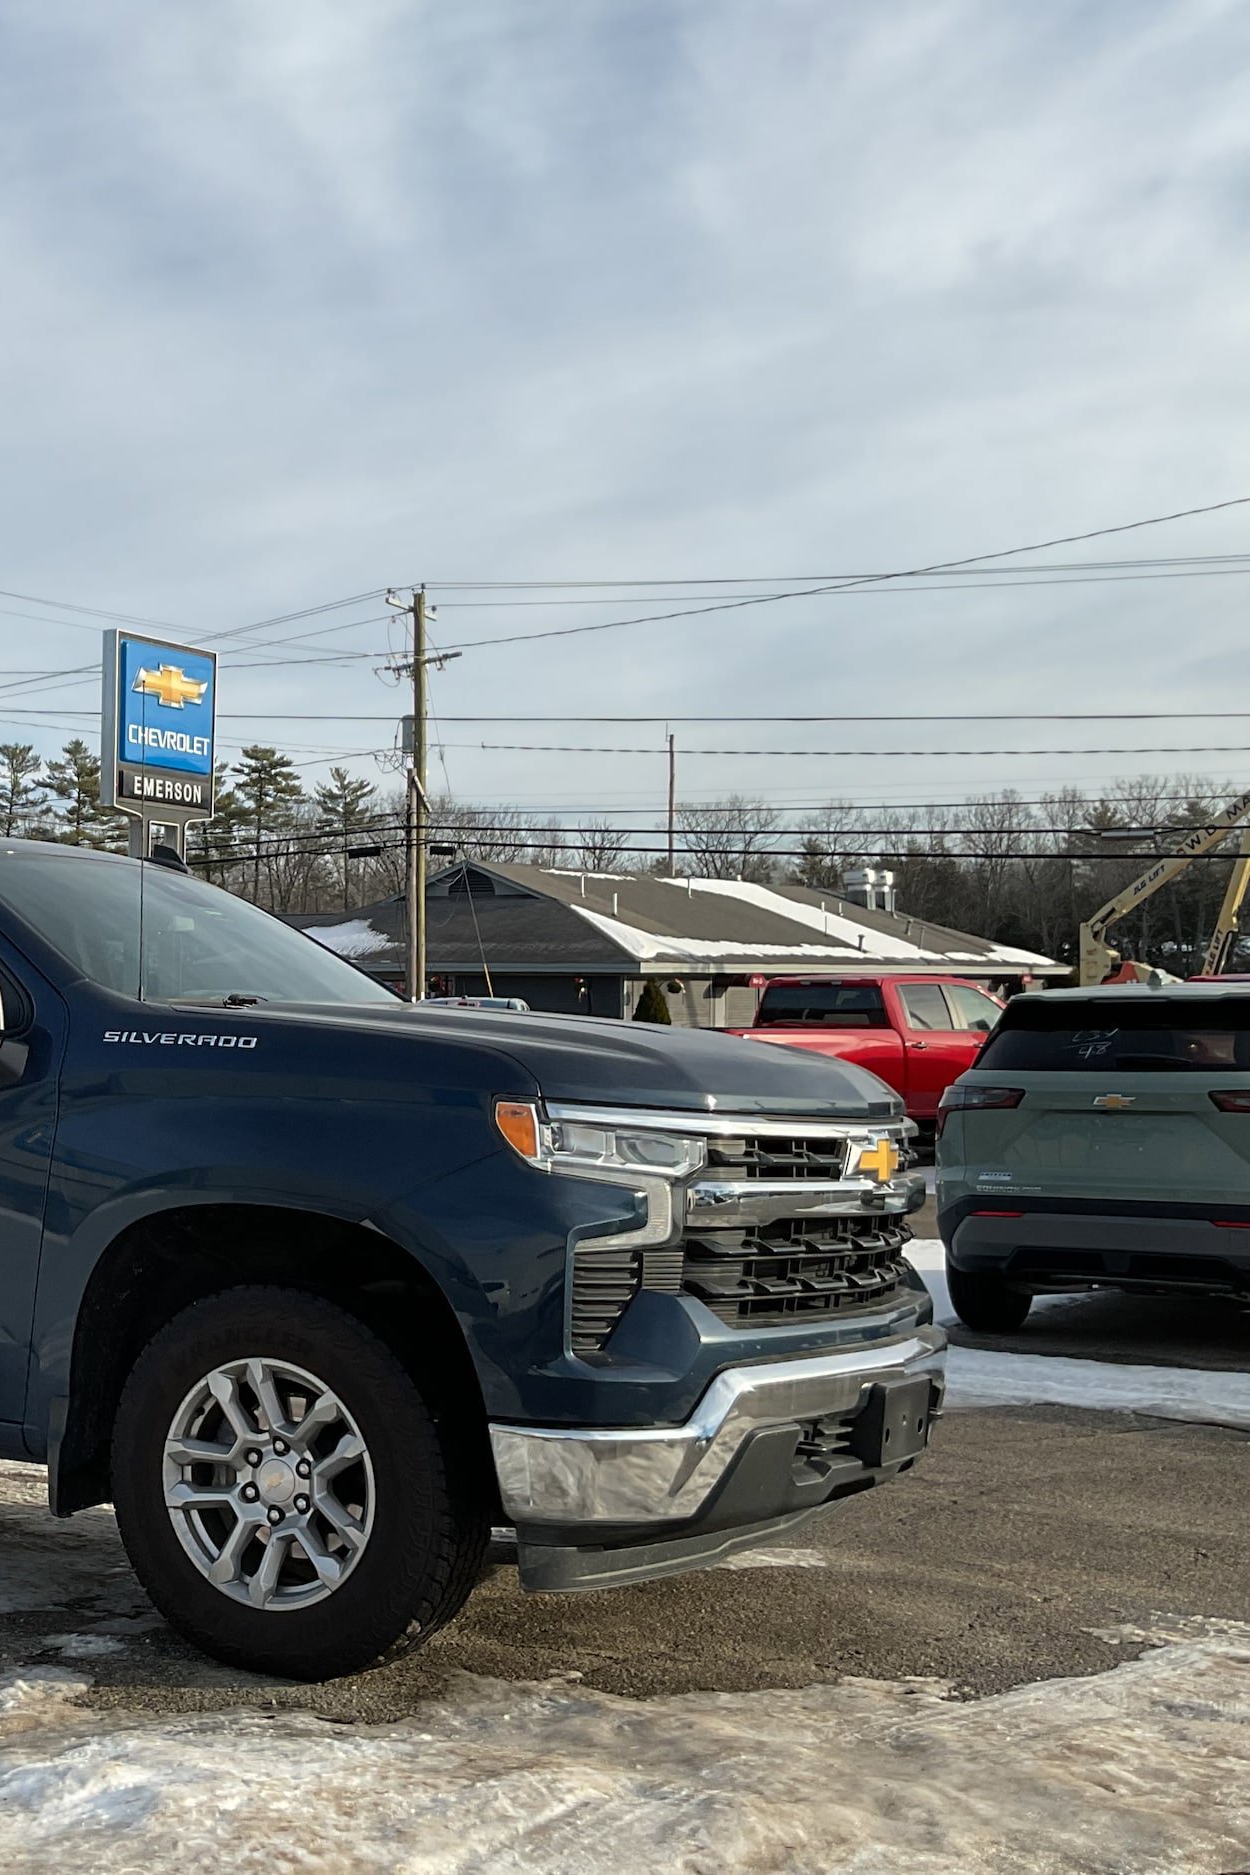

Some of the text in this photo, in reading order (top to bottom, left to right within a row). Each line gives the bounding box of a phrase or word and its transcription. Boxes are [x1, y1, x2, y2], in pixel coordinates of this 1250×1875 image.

[128, 724, 210, 756] CHEVROLET
[133, 775, 202, 804] EMERSON
[1148, 864, 1165, 882] LIFT
[103, 1031, 258, 1049] SILVERADO
